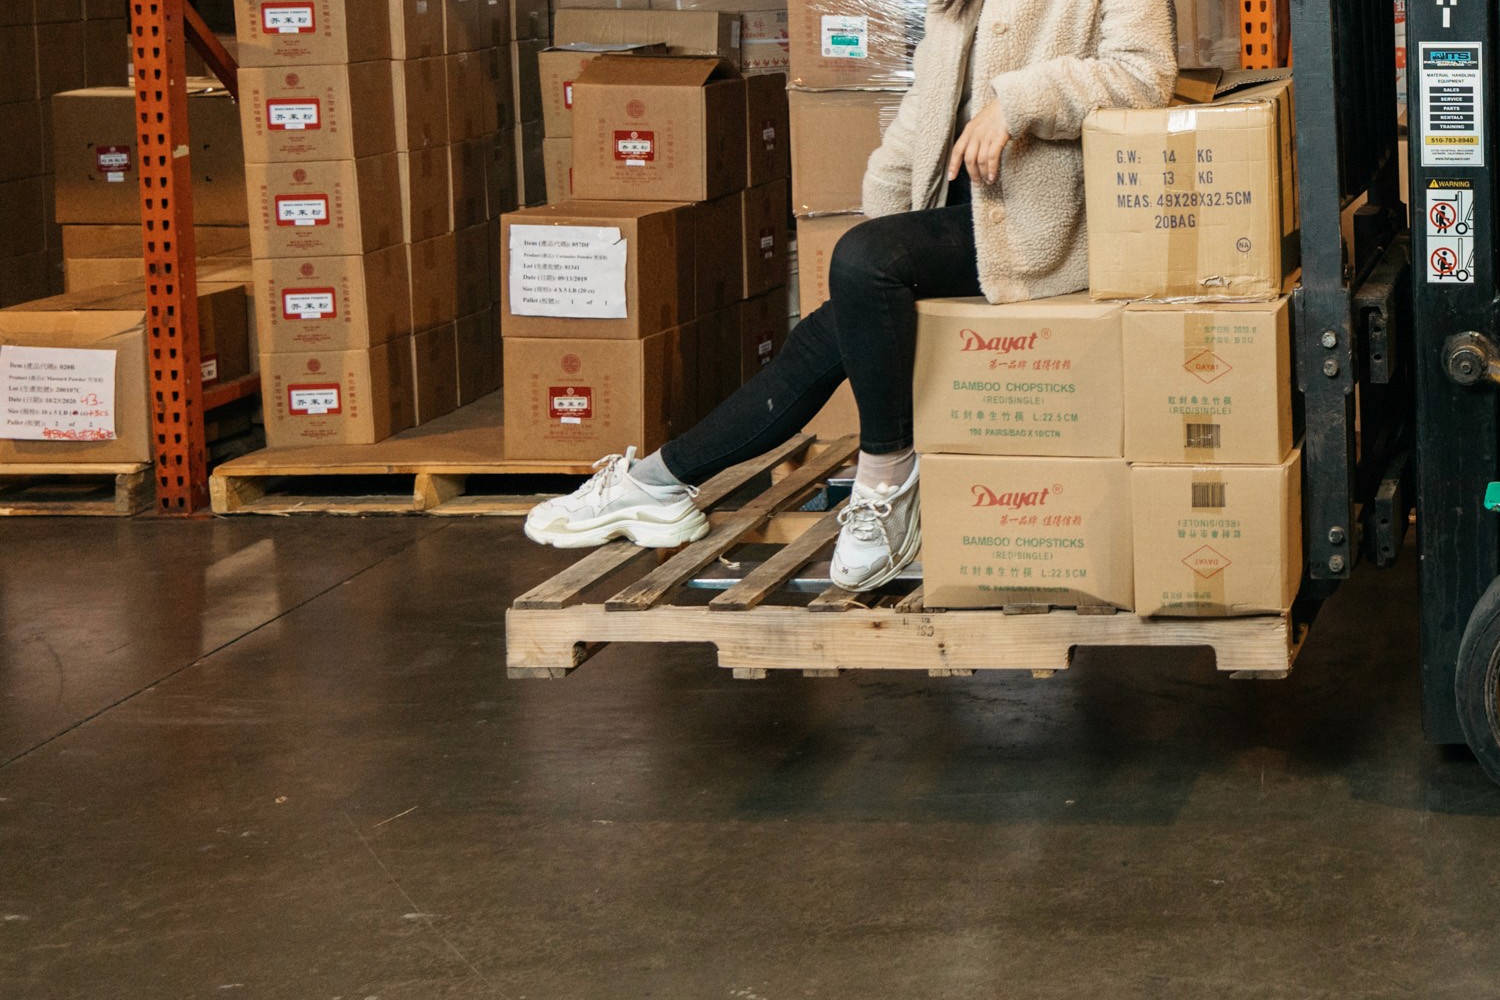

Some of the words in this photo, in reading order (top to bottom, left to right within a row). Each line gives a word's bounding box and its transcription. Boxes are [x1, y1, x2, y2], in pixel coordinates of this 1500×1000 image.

[1162, 150, 1176, 164] 14
[1197, 149, 1213, 163] KG
[1162, 172, 1174, 185] 13
[1198, 170, 1213, 184] KG
[1156, 190, 1252, 208] 49X28X32.5CM
[1154, 214, 1196, 229] 20BAG
[960, 328, 1038, 354] Dayat
[953, 381, 1000, 392] BAMBOO
[1006, 382, 1076, 393] CHOPSTICKS
[1168, 407, 1232, 415] (RED/SINGLE)
[971, 484, 1050, 510] Dayat
[962, 536, 1010, 547] BAMBOO
[1016, 537, 1085, 548] CHOPSTICKS
